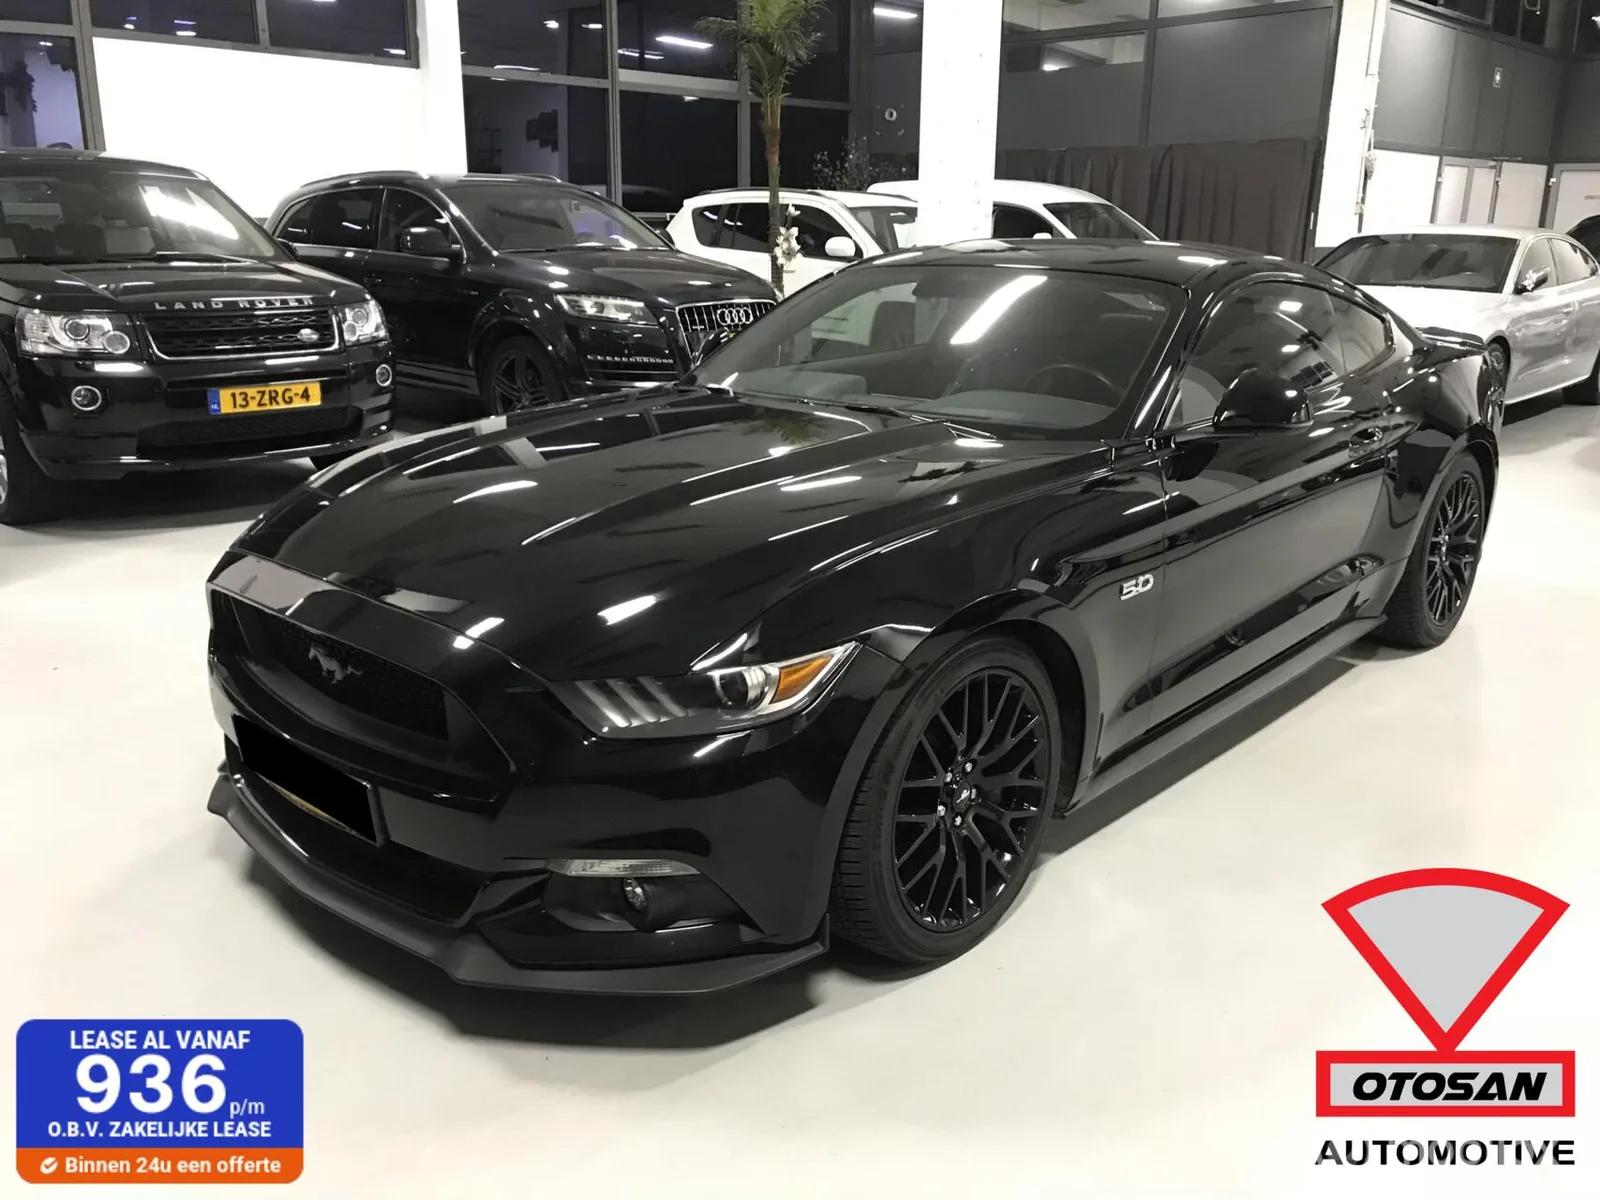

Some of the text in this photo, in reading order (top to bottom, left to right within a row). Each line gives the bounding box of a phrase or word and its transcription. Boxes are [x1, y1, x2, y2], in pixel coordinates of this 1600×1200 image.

[154, 297, 313, 310] LAND ROVER
[231, 386, 310, 409] 13-ZRG-4
